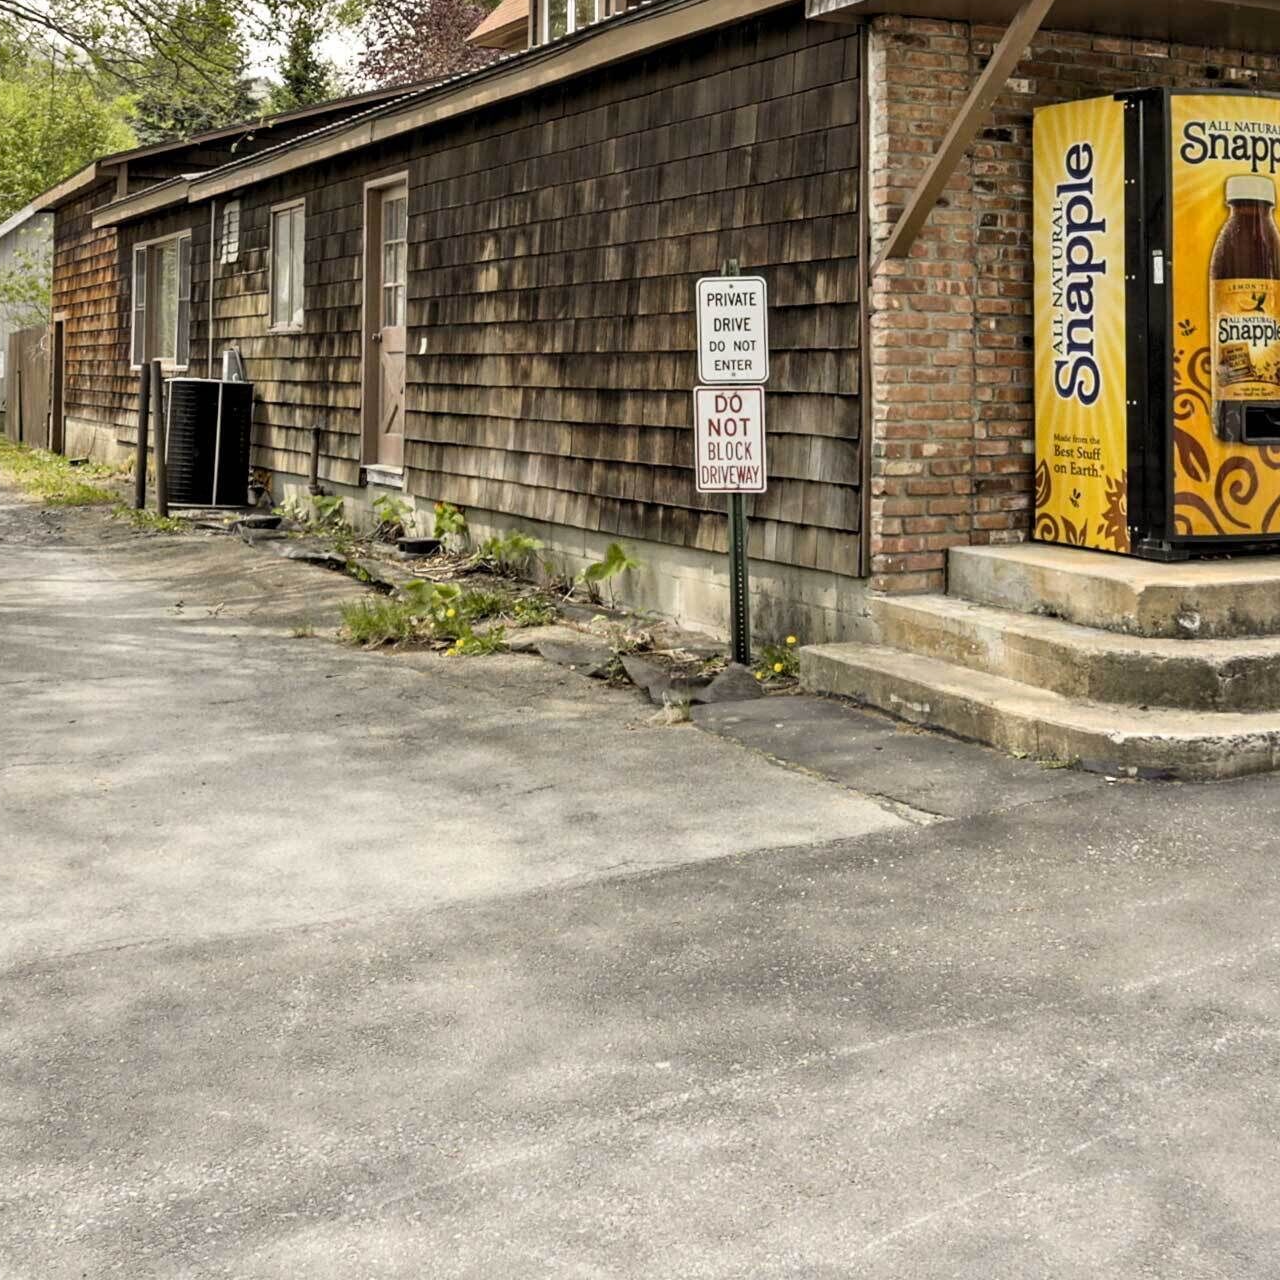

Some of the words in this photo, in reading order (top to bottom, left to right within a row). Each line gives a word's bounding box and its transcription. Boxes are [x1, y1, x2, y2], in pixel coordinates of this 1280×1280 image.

[1208, 121, 1231, 132] ALL
[1052, 201, 1063, 307] NATURAL
[1055, 143, 1106, 405] Snapple
[707, 292, 757, 307] PRIVATE
[713, 317, 752, 332] DRIVE
[1053, 314, 1063, 354] ALL
[709, 341, 725, 352] DO
[733, 340, 757, 352] NOT
[714, 359, 753, 371] ENTER
[715, 394, 743, 413] DO
[708, 418, 751, 437] NOT
[1054, 433, 1071, 441] Made
[1073, 434, 1087, 444] from
[1089, 436, 1100, 444] the
[708, 441, 752, 461] BLOCK
[1054, 444, 1074, 457] Best
[1077, 447, 1101, 460] Stuff
[702, 465, 760, 484] DRIVEWAY
[1054, 464, 1067, 474] on
